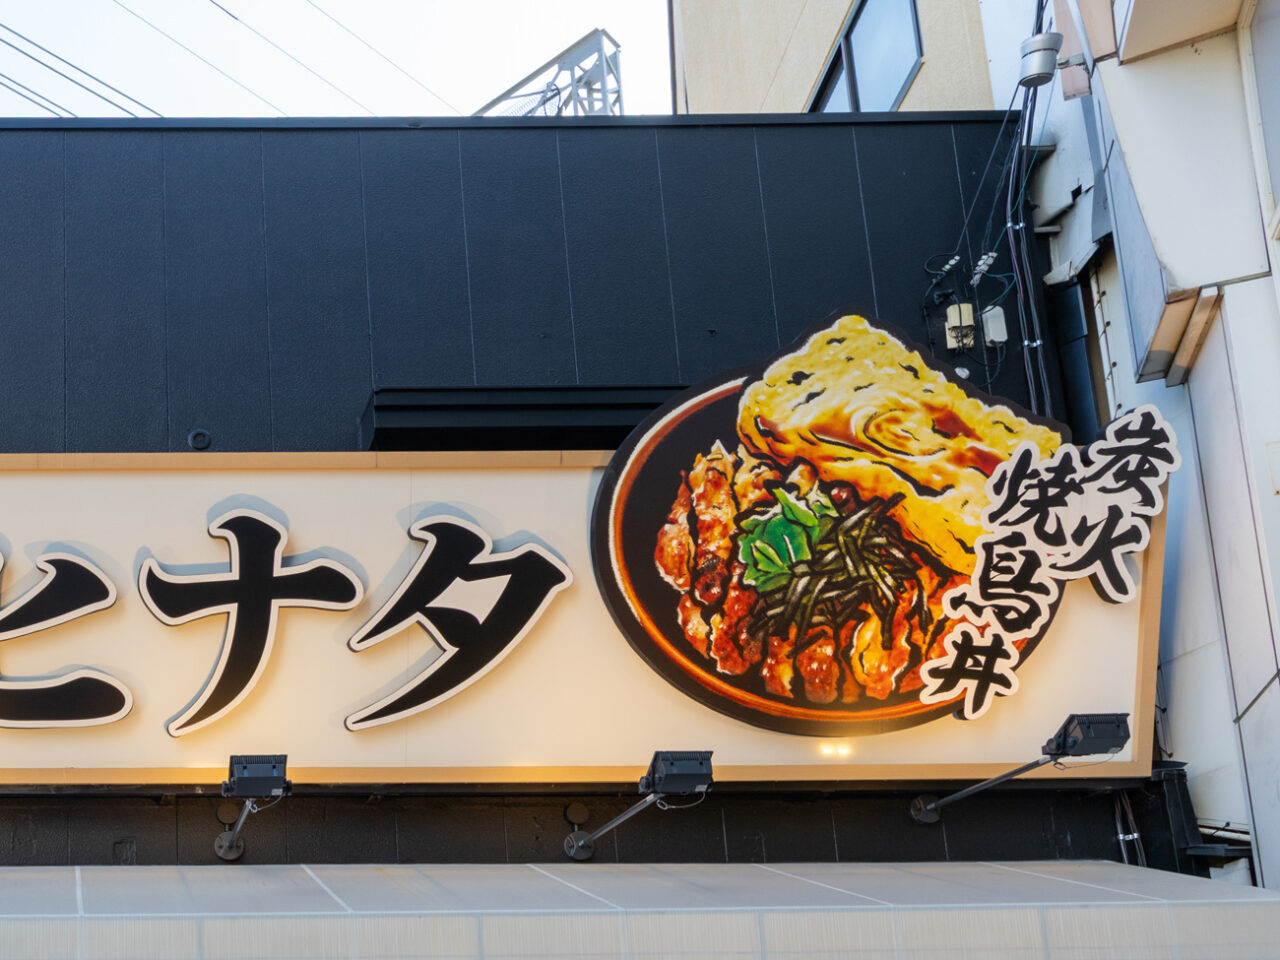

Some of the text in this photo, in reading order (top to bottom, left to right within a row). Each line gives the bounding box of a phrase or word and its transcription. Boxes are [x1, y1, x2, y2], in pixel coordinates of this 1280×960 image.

[927, 448, 1084, 715] 焼鳥丼
[1050, 411, 1176, 597] 炭火
